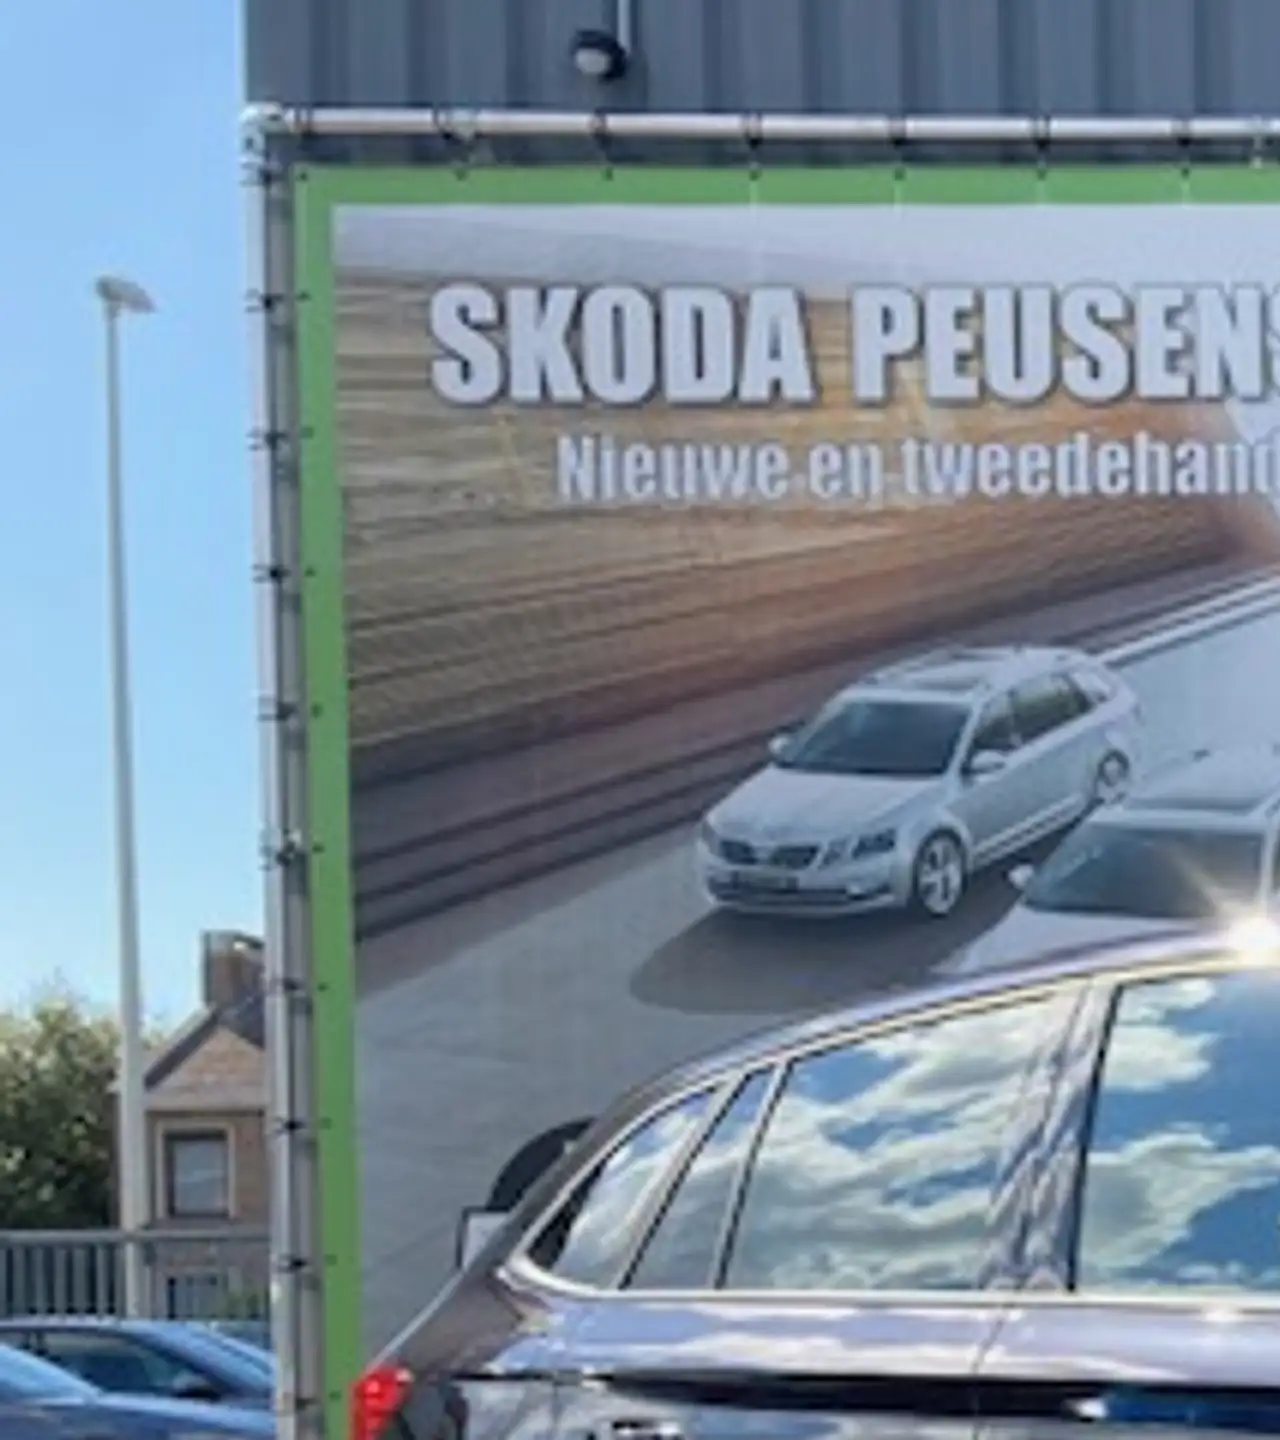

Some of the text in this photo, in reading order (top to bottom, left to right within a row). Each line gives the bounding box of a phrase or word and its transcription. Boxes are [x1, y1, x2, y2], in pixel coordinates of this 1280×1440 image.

[426, 283, 816, 406] SKODA
[555, 434, 792, 502] Nieuwe
[806, 444, 884, 502] en
